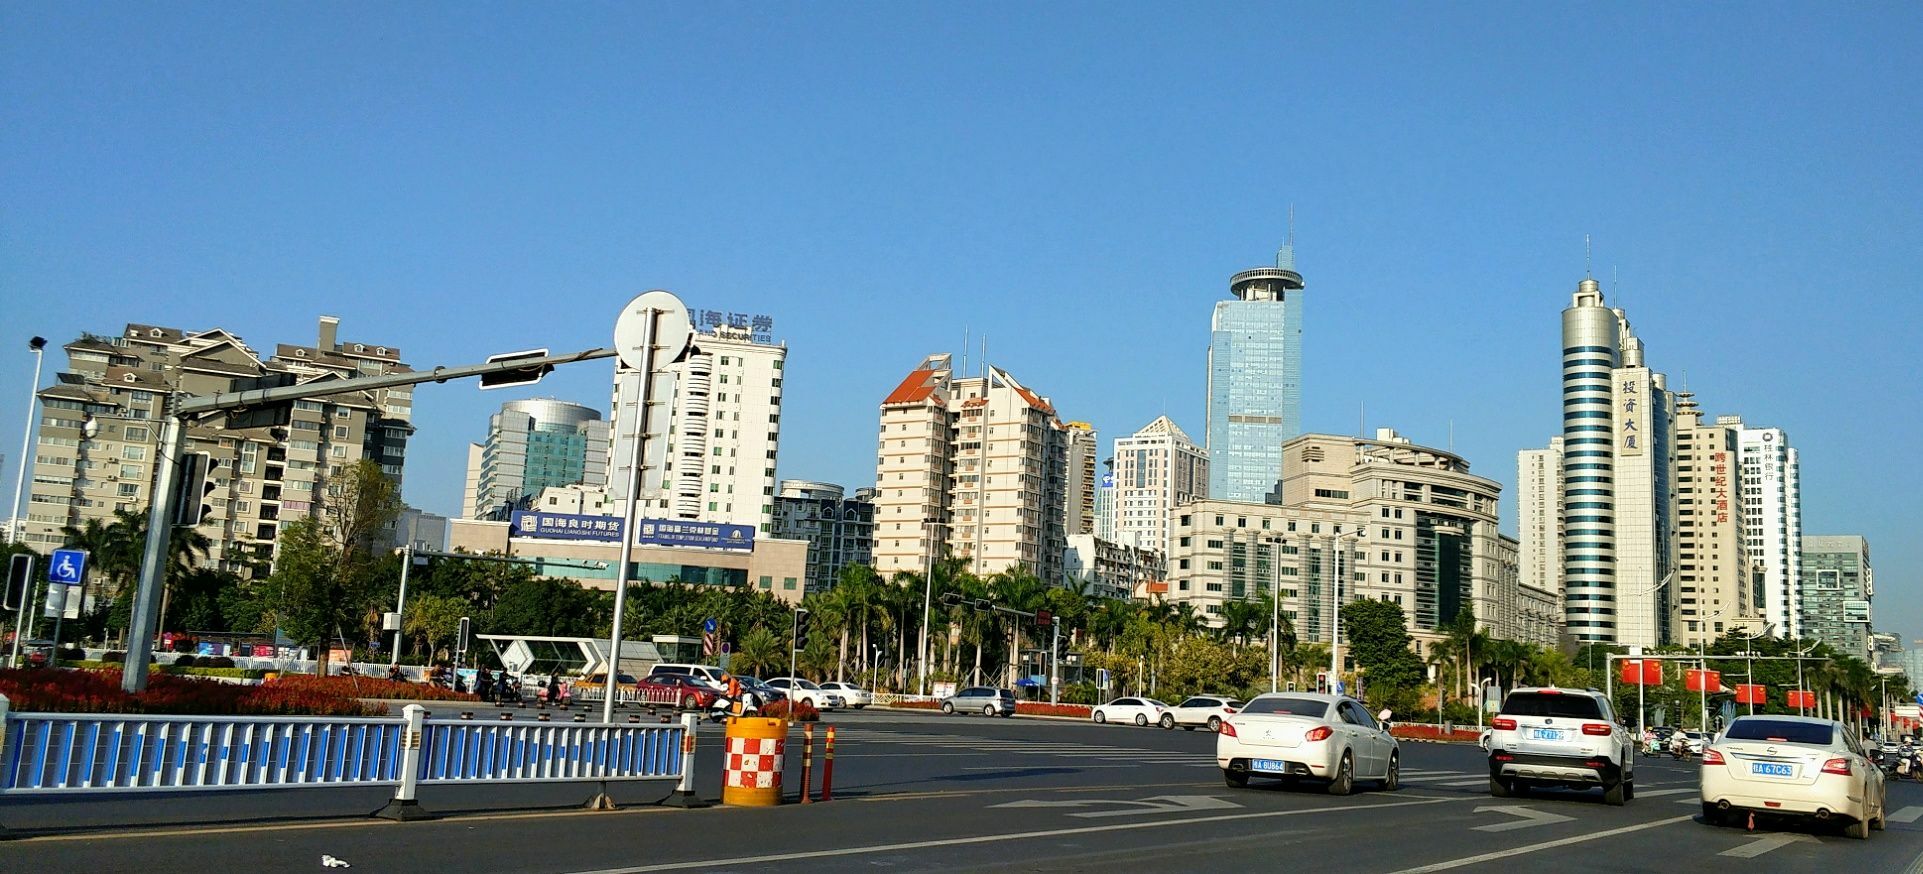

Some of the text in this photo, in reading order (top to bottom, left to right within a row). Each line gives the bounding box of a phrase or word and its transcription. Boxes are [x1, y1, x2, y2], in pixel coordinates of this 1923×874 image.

[720, 330, 771, 342] SECURITIES
[1764, 444, 1774, 480] 桂林银行
[1714, 452, 1728, 523] 跨世纪大酒店
[542, 517, 619, 531] 国海良时期货
